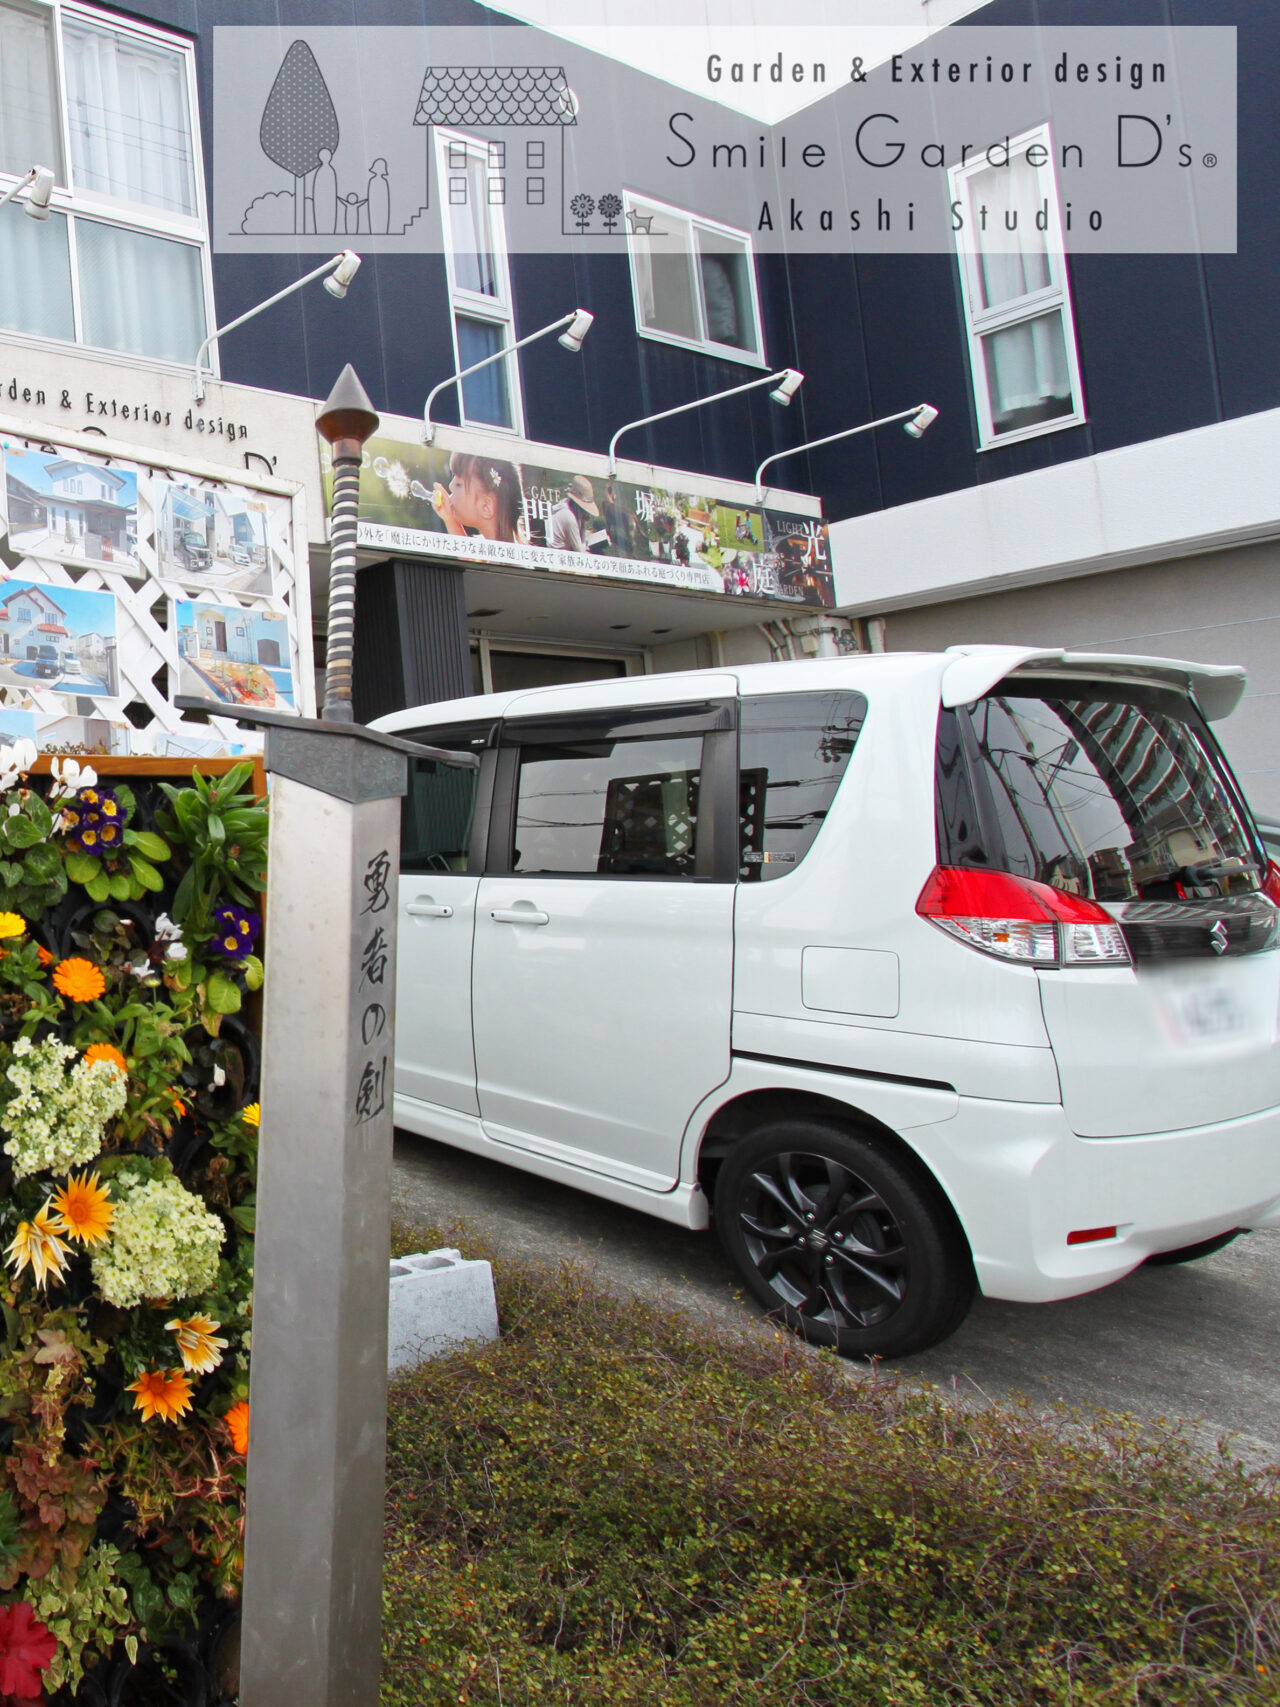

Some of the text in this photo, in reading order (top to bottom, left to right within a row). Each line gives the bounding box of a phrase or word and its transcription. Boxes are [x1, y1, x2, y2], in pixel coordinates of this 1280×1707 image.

[60, 389, 73, 410] &
[86, 392, 172, 426] Exterior
[184, 408, 249, 442] design
[530, 485, 561, 502] GATE
[800, 520, 827, 562] 光
